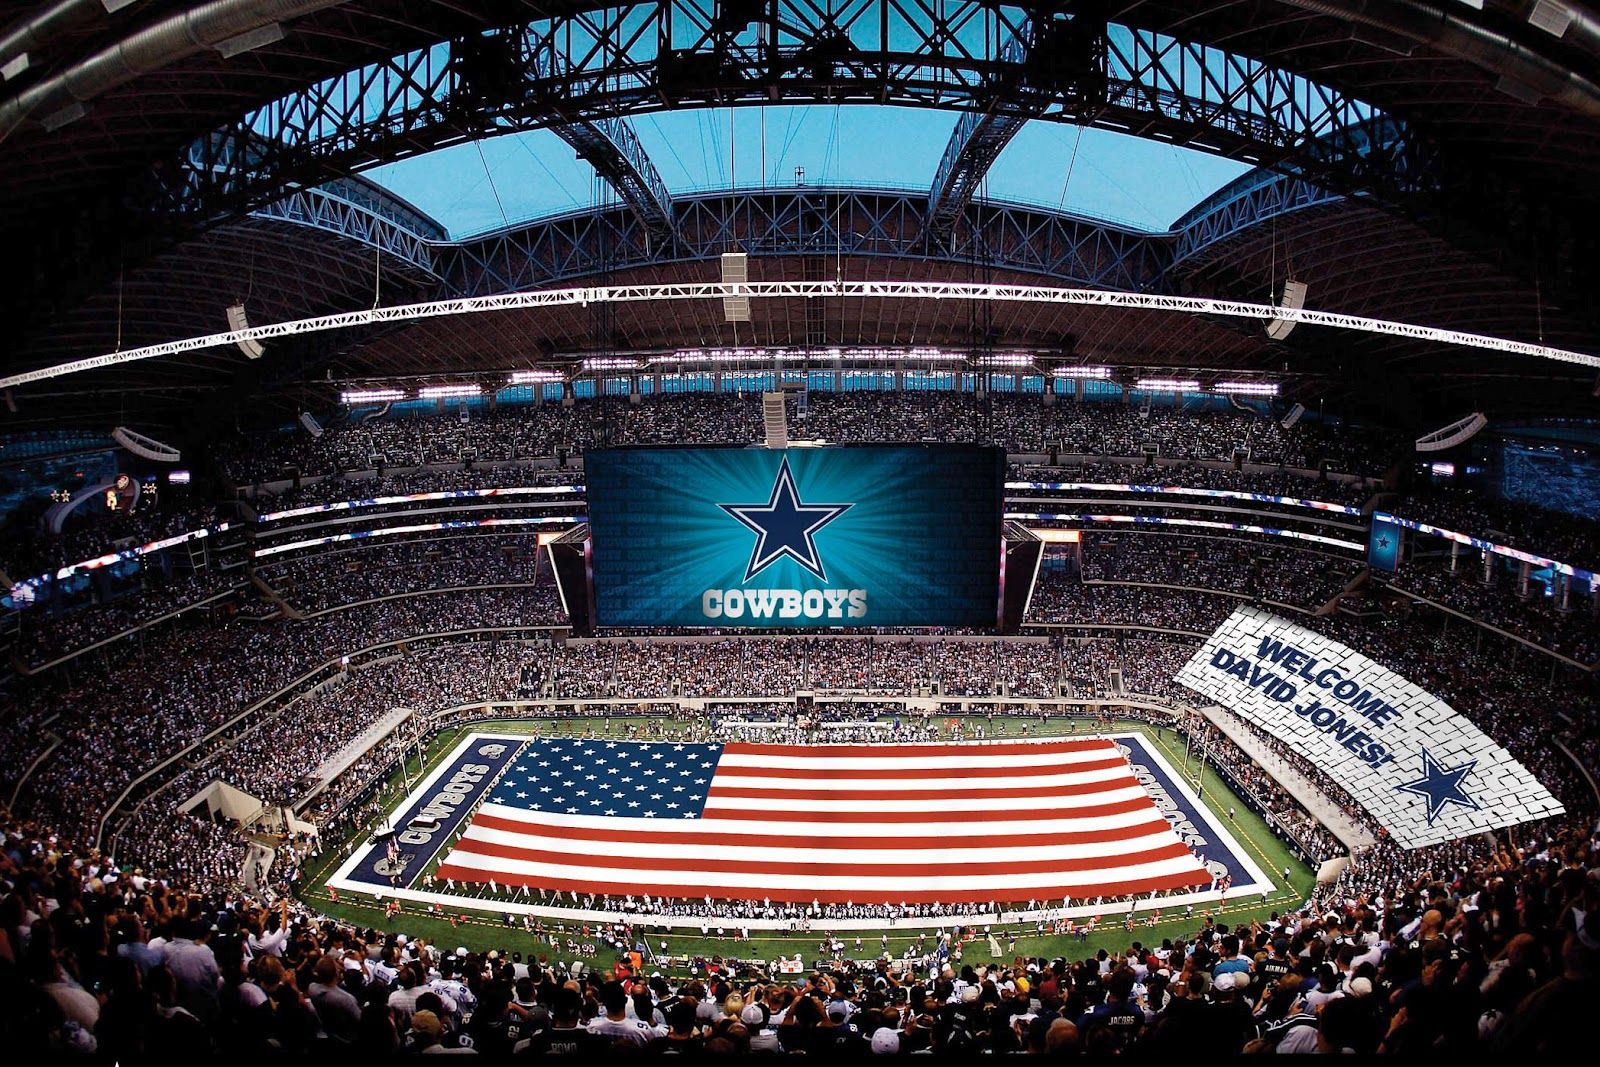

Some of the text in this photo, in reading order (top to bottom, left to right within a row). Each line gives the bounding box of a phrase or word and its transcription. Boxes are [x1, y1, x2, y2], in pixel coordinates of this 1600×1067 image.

[702, 588, 868, 619] COWBOYS
[1210, 648, 1396, 769] DAVID JONES!
[1256, 636, 1398, 729] WELCOME
